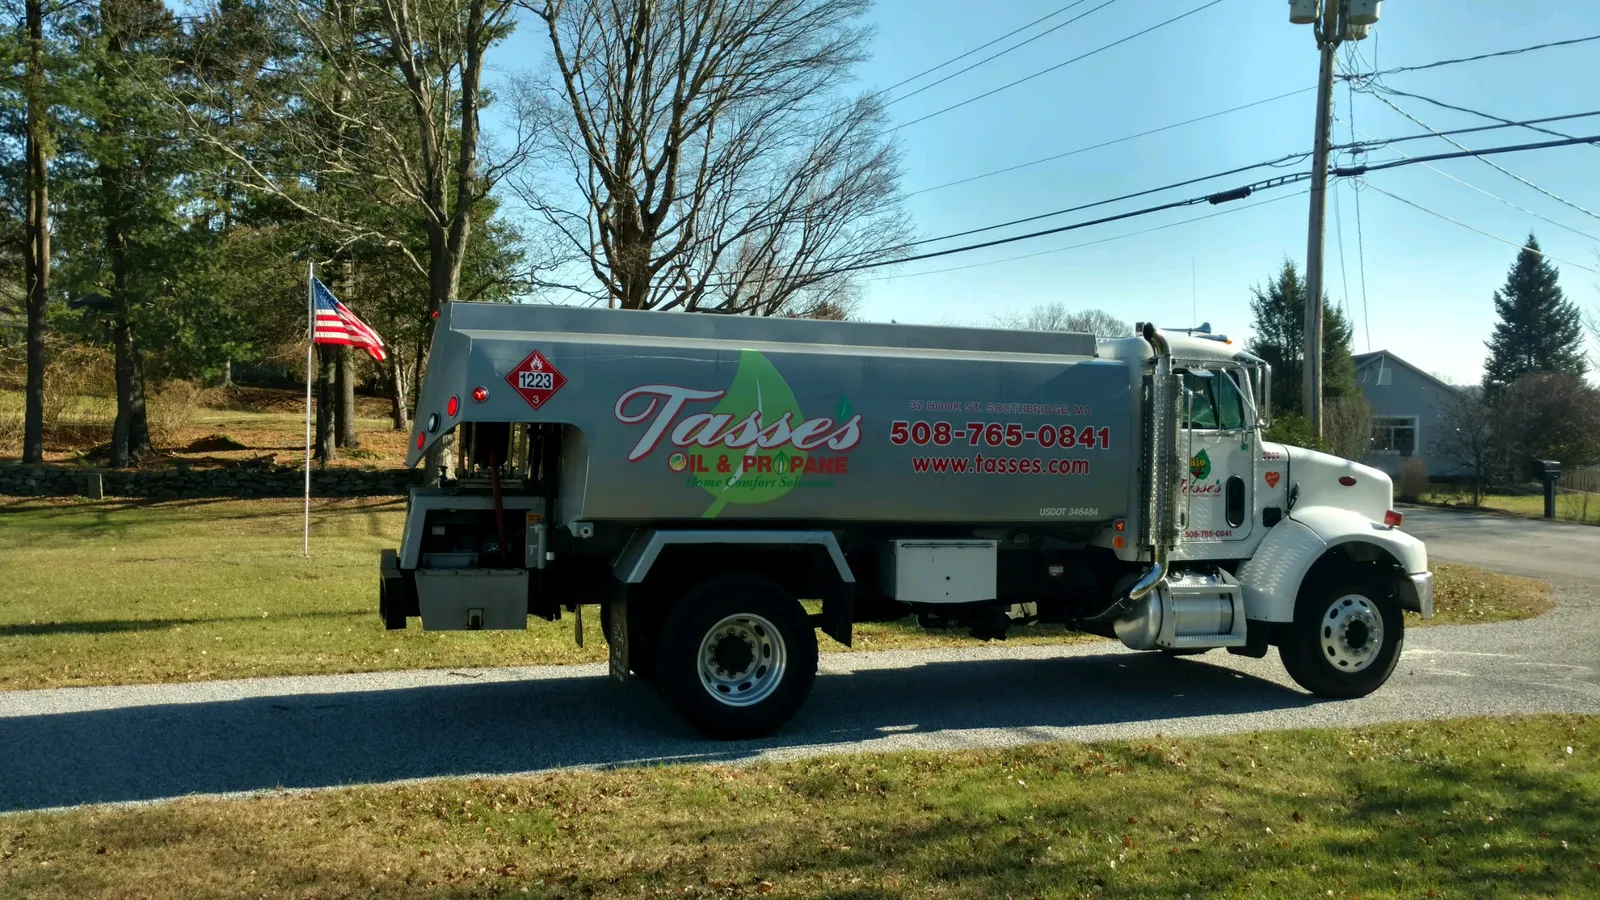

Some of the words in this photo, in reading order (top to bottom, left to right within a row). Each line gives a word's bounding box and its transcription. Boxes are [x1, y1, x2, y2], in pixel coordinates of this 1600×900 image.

[520, 373, 551, 389] 1223
[532, 394, 540, 404] 3
[909, 400, 923, 411] 37
[926, 401, 962, 412] HOOK
[965, 402, 982, 413] ST.
[986, 402, 1071, 417] SOUTHBRIDGE,
[1074, 403, 1092, 416] MA
[614, 384, 864, 462] Tasse's
[889, 420, 1111, 450] 508-765-0841
[668, 451, 709, 473] OIL
[716, 454, 732, 473] &
[742, 450, 848, 474] PROPANE
[912, 452, 1090, 475] www.tasses.com
[685, 476, 721, 488] Home
[725, 476, 776, 489] Comfort
[778, 476, 835, 488] Solutions
[1039, 507, 1067, 516] USDOT
[1068, 507, 1099, 516] 346484
[1185, 530, 1232, 538] 508-765-0841
